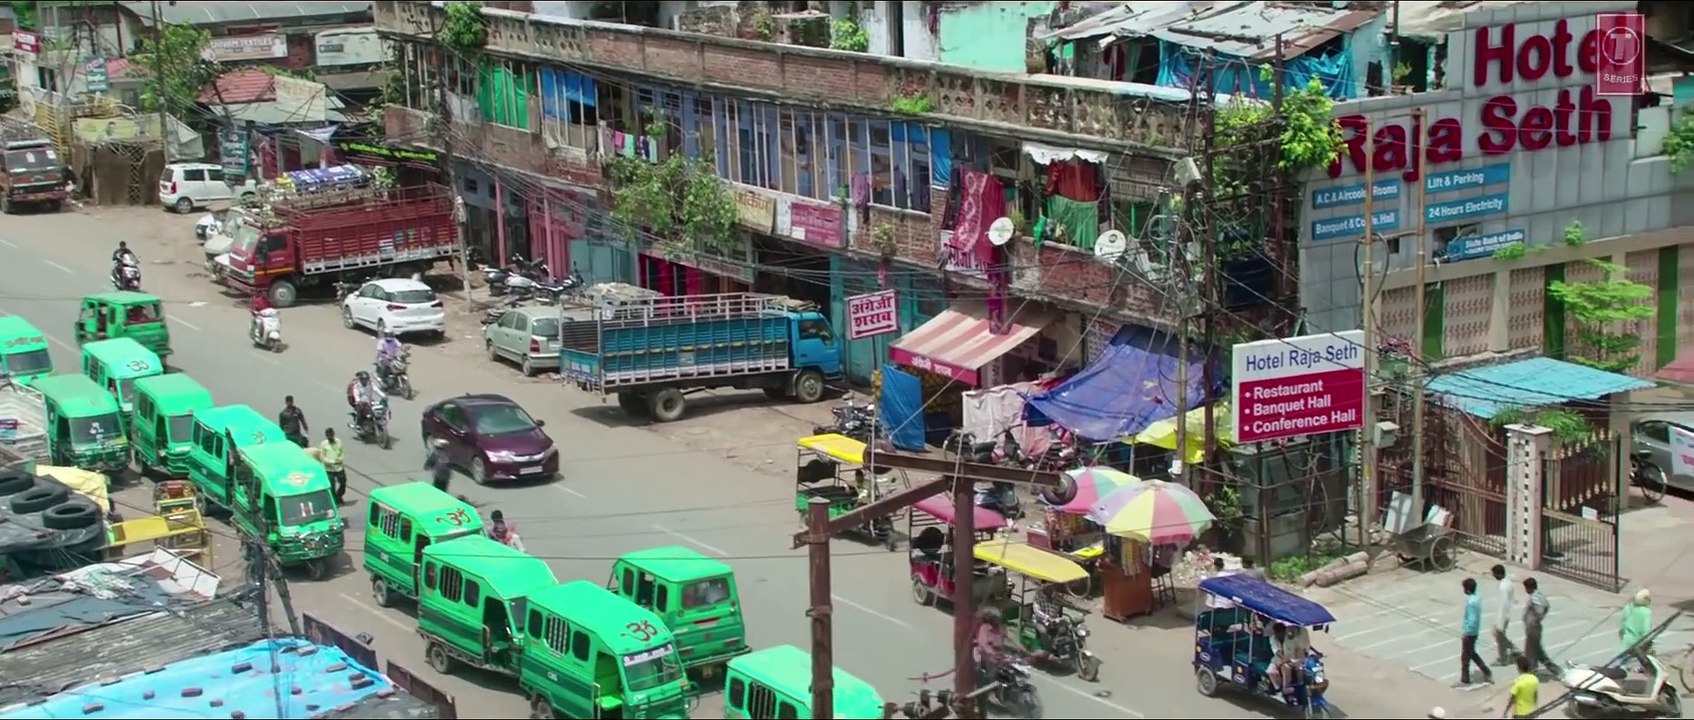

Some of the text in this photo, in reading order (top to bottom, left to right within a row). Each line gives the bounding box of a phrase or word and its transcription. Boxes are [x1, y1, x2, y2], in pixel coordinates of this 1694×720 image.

[1474, 11, 1628, 87] Hotel
[1327, 85, 1612, 182] Raja Seth
[1372, 185, 1397, 196] Rooms
[1428, 173, 1484, 189] Lift & Parking
[1428, 198, 1503, 218] 24 Hours Electricity
[1316, 220, 1347, 234] Banquet
[1246, 343, 1358, 372] Hotel Raja Seth
[1253, 379, 1323, 400] Restaurant
[1253, 394, 1331, 416] Banquet Hall
[1253, 409, 1356, 434] Conference Hall
